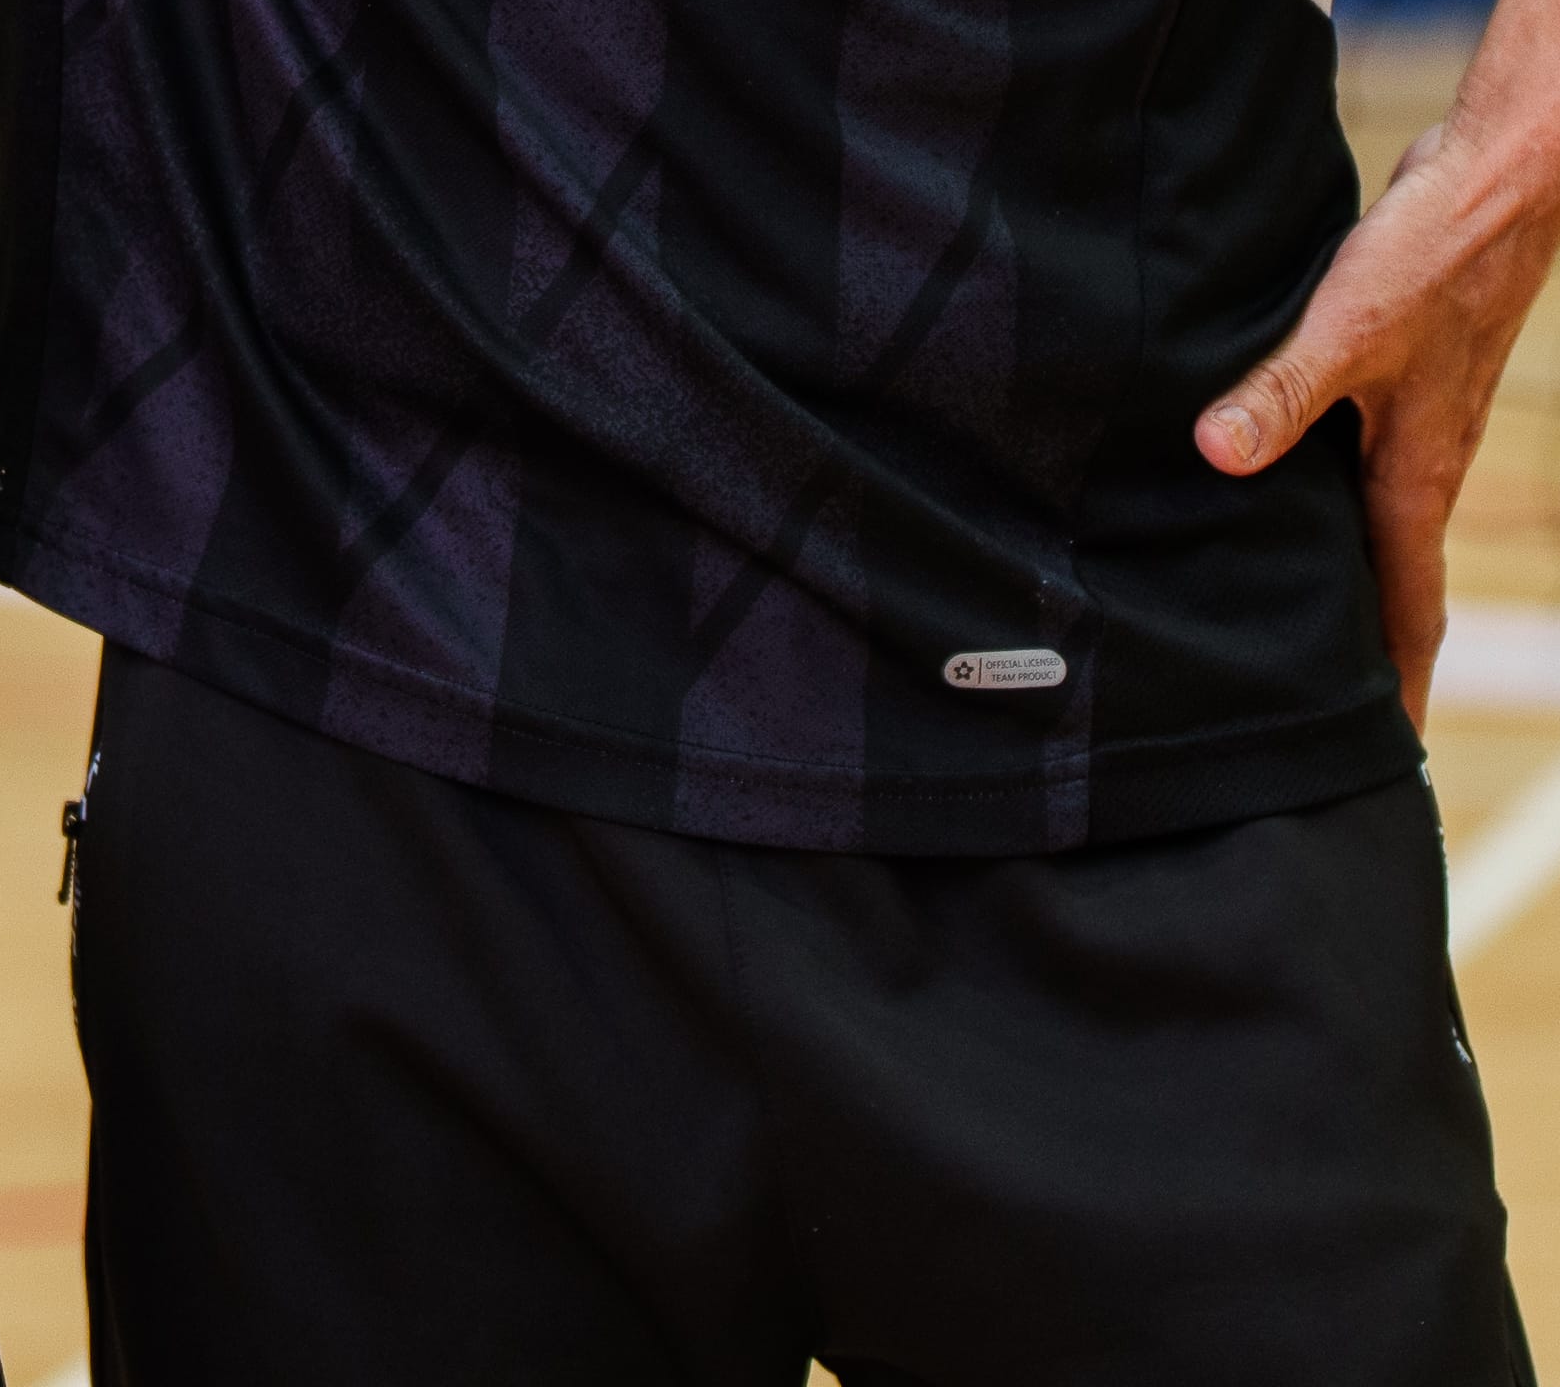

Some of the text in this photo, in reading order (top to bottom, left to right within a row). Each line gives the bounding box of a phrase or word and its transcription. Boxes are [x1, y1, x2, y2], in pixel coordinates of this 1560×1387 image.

[985, 657, 1061, 670] OFFICIAL LICENSED
[991, 671, 1057, 683] TEAM PRODUCT
